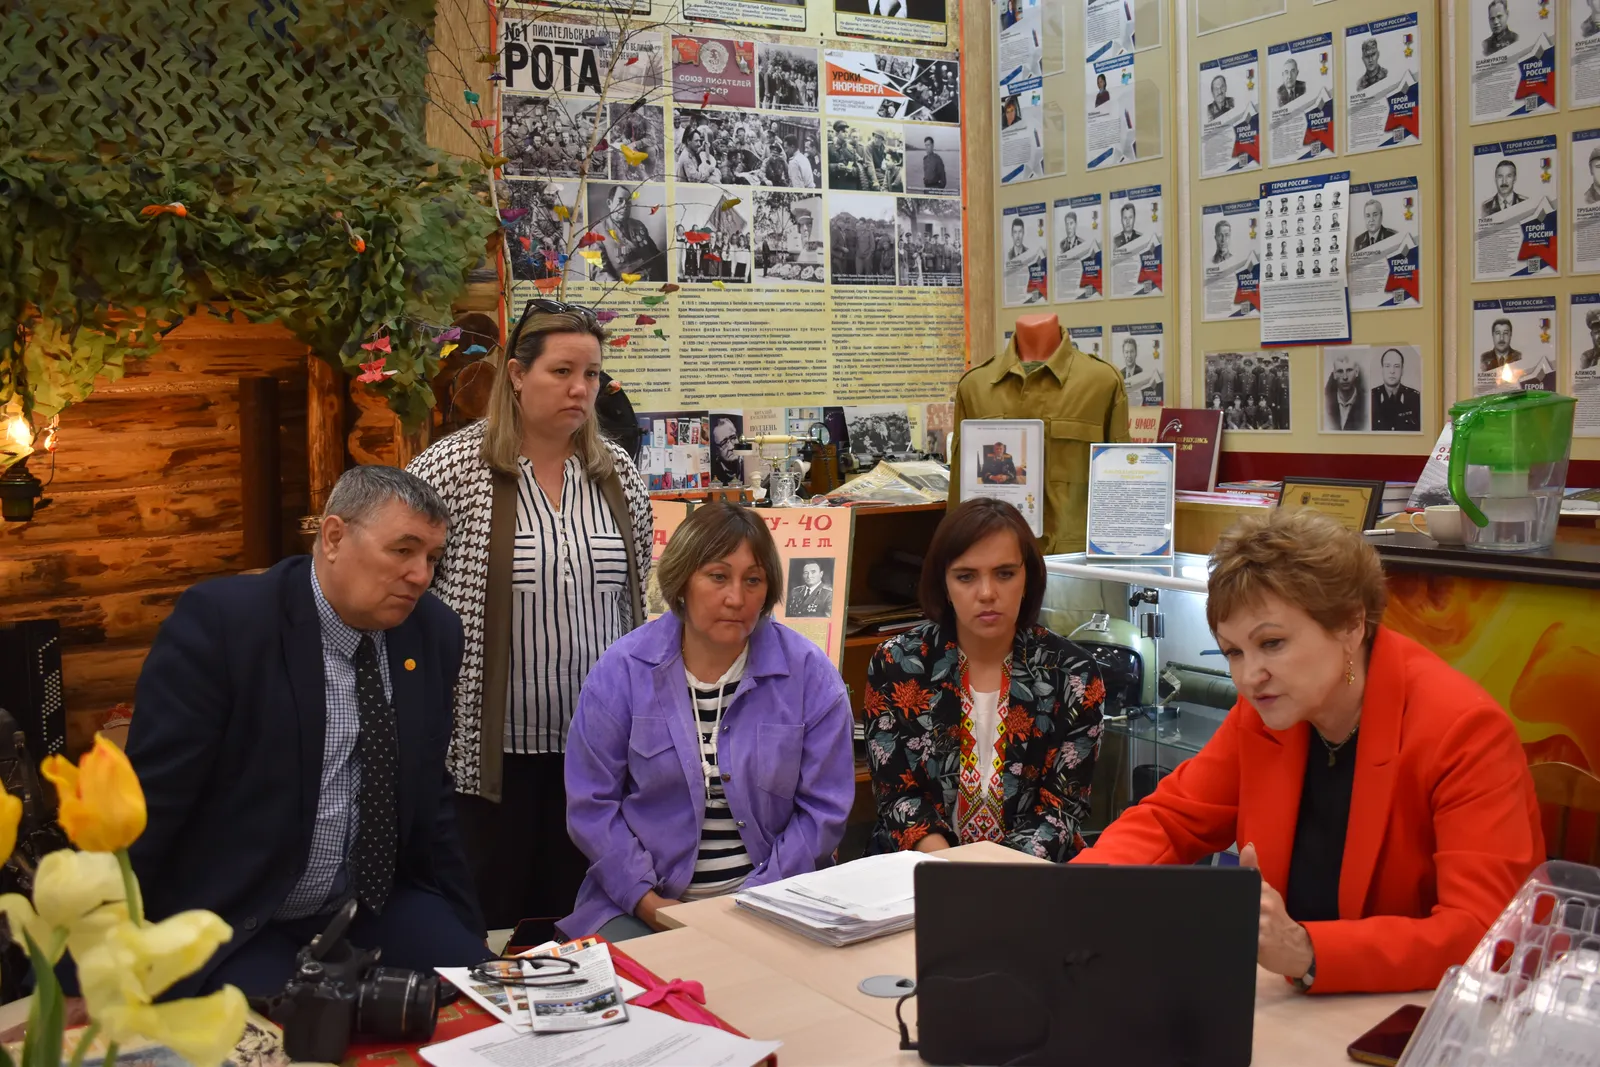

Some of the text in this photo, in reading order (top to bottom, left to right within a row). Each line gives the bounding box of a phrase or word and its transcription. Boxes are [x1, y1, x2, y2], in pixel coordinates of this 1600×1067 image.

[504, 21, 596, 42] №1 ПИСАТЕЛЬСКАЯ
[504, 42, 603, 97] РОТА
[1523, 60, 1543, 71] ГЕРОЙ
[832, 71, 861, 82] УРОКИ
[1526, 66, 1552, 77] РОССИИ
[679, 74, 752, 88] СОЮЗ ПИСАТЕЛЕЙ
[832, 81, 884, 95] НЮРНБЕРГА
[1391, 95, 1408, 105] ГЕРОЙ
[1393, 101, 1416, 111] РОССИИ
[1308, 110, 1325, 121] ГЕРОЙ
[1310, 117, 1331, 127] РОССИИ
[1236, 124, 1251, 133] ГЕРОЙ
[1238, 130, 1257, 138] РОССИИ
[1272, 181, 1287, 190] ГЕРОИ
[1525, 223, 1545, 232] ГЕРОЙ
[1528, 230, 1554, 239] РОССИИ
[1391, 258, 1409, 266] ГЕРОЙ
[1393, 264, 1416, 272] РОССИИ
[1524, 382, 1544, 390] ГЕРОЙ
[749, 424, 778, 432] ПОЛДЕНЬ
[798, 514, 833, 531] 40
